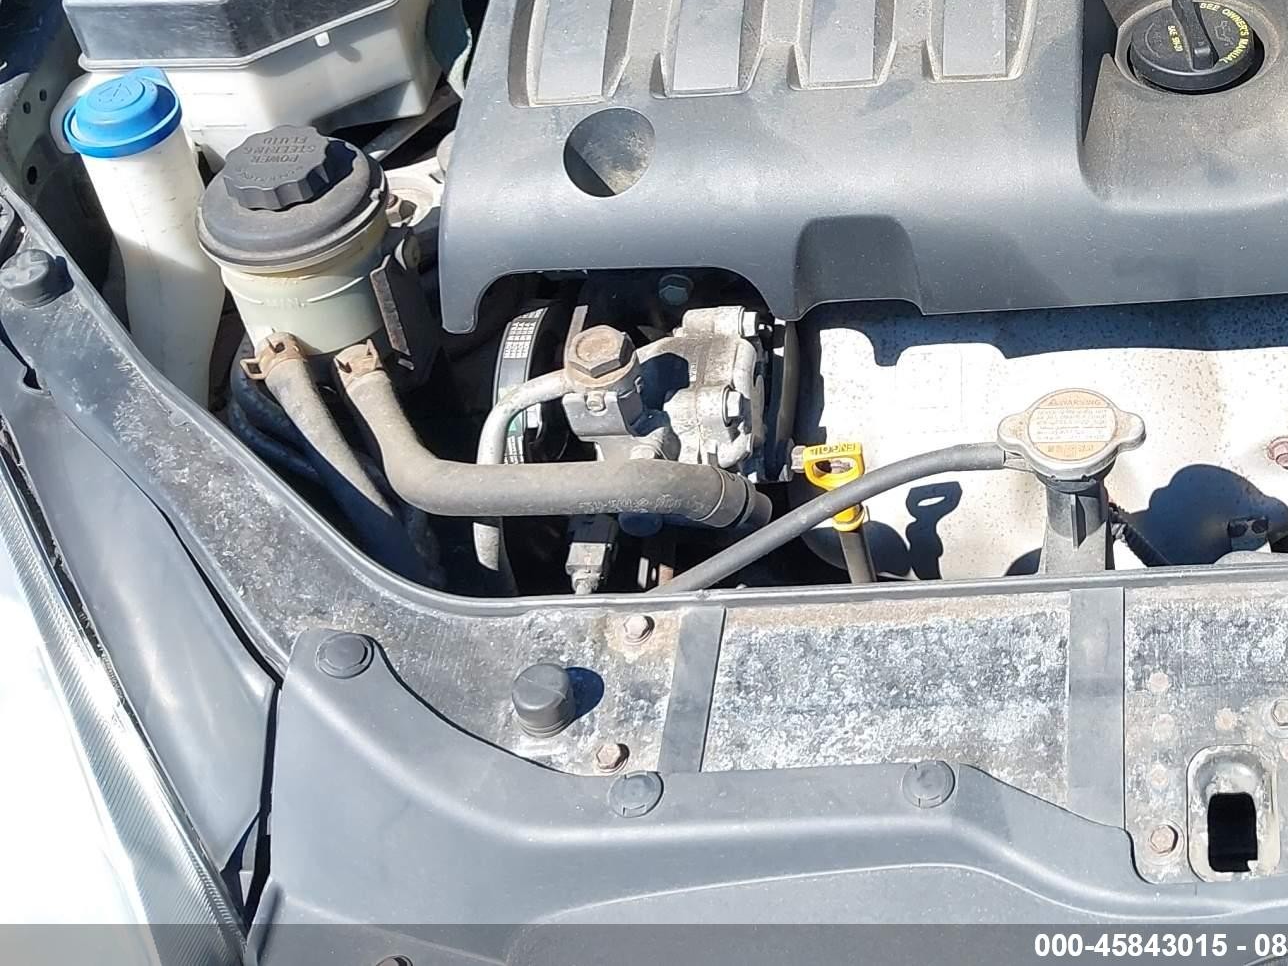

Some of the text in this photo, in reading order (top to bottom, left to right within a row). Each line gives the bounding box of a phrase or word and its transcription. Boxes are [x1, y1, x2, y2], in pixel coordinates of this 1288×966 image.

[1200, 2, 1250, 63] SEE OWNER'S MANUAL
[262, 136, 308, 145] FLUID
[242, 145, 317, 155] STEERING
[249, 154, 300, 164] POWER
